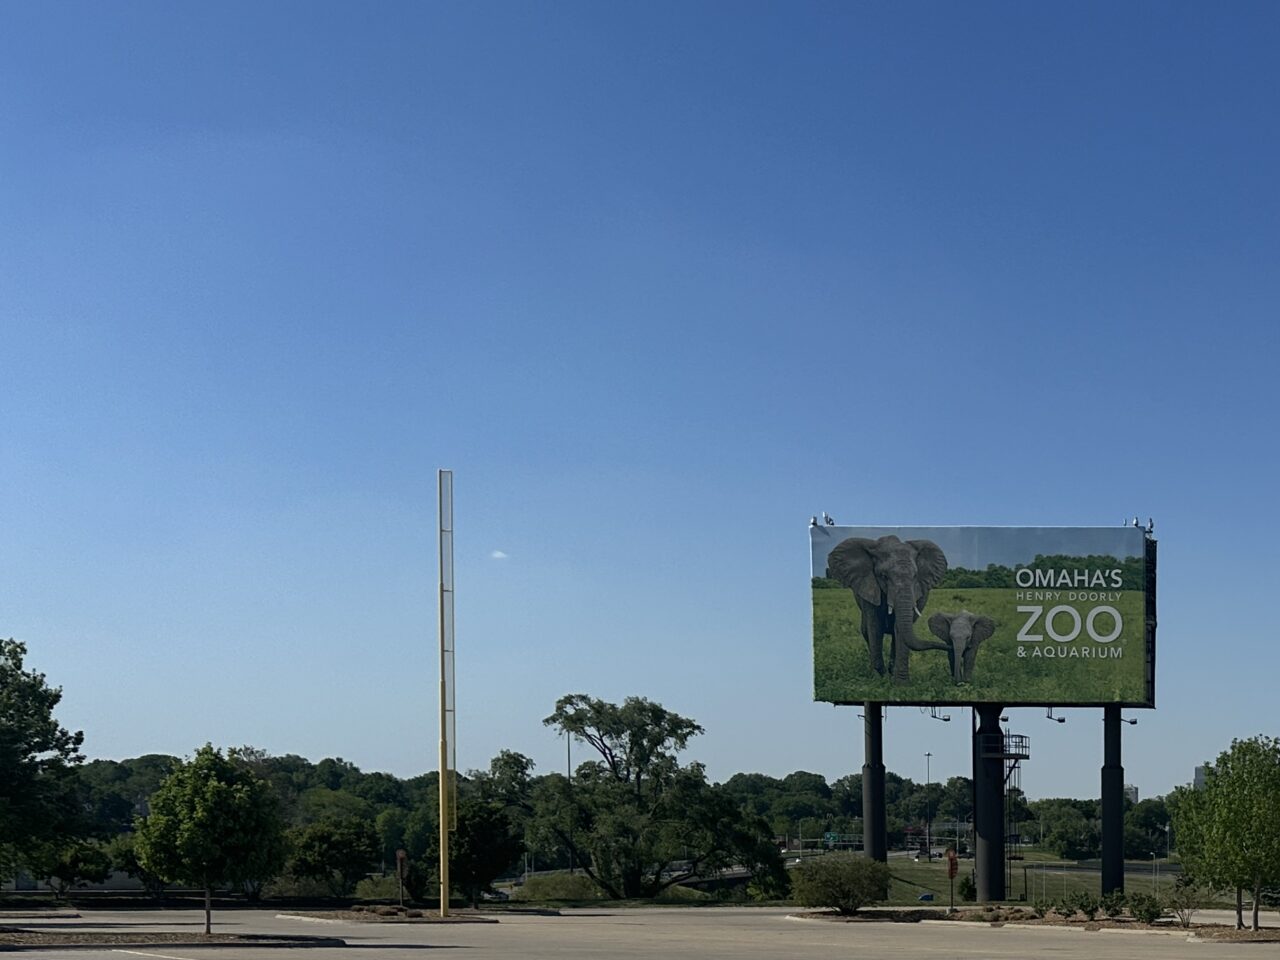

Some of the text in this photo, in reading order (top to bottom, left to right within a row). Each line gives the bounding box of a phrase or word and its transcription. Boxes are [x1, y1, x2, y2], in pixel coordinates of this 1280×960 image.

[1016, 568, 1123, 588] OMAHA'S
[1016, 591, 1122, 601] HENRY DOORLY
[1016, 604, 1123, 643] ZOO
[1016, 646, 1122, 658] & AQUARIUM
